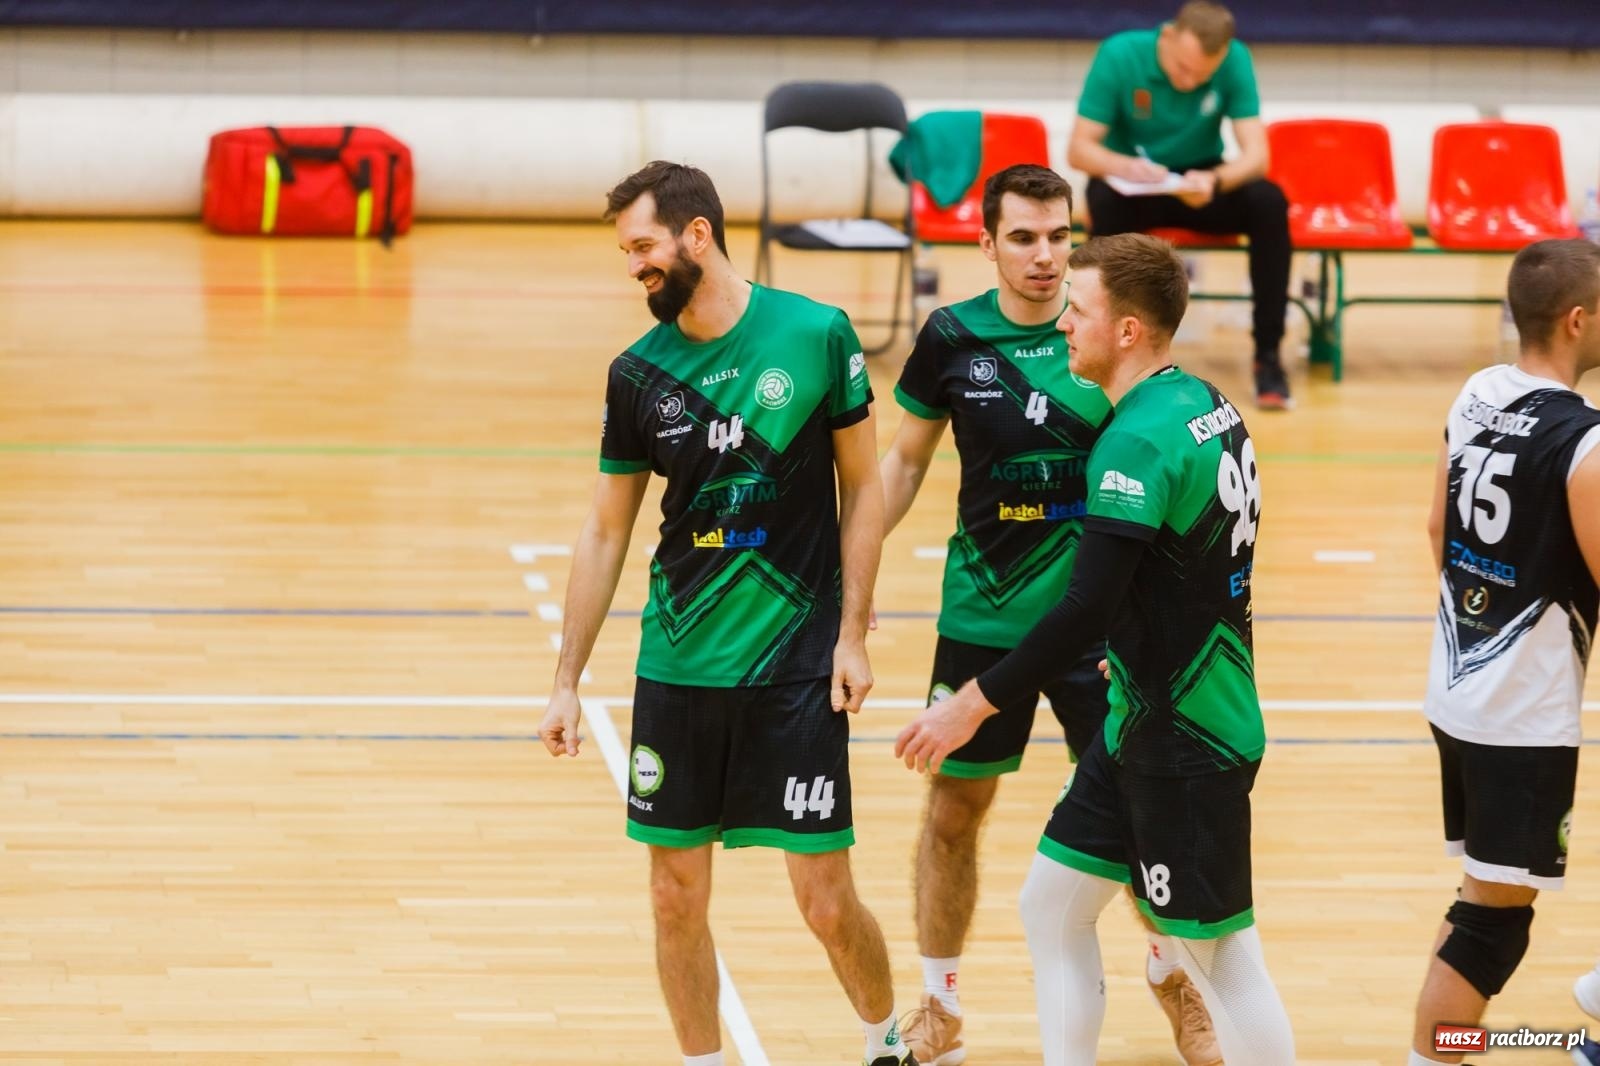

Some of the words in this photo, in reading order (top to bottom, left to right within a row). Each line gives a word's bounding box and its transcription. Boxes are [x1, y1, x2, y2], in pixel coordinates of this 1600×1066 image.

[1014, 347, 1054, 358] ALLSIX
[701, 368, 740, 387] ALLSIX
[1025, 391, 1048, 425] 4
[707, 414, 744, 454] 44
[1217, 437, 1261, 557] 98
[783, 775, 835, 820] 44
